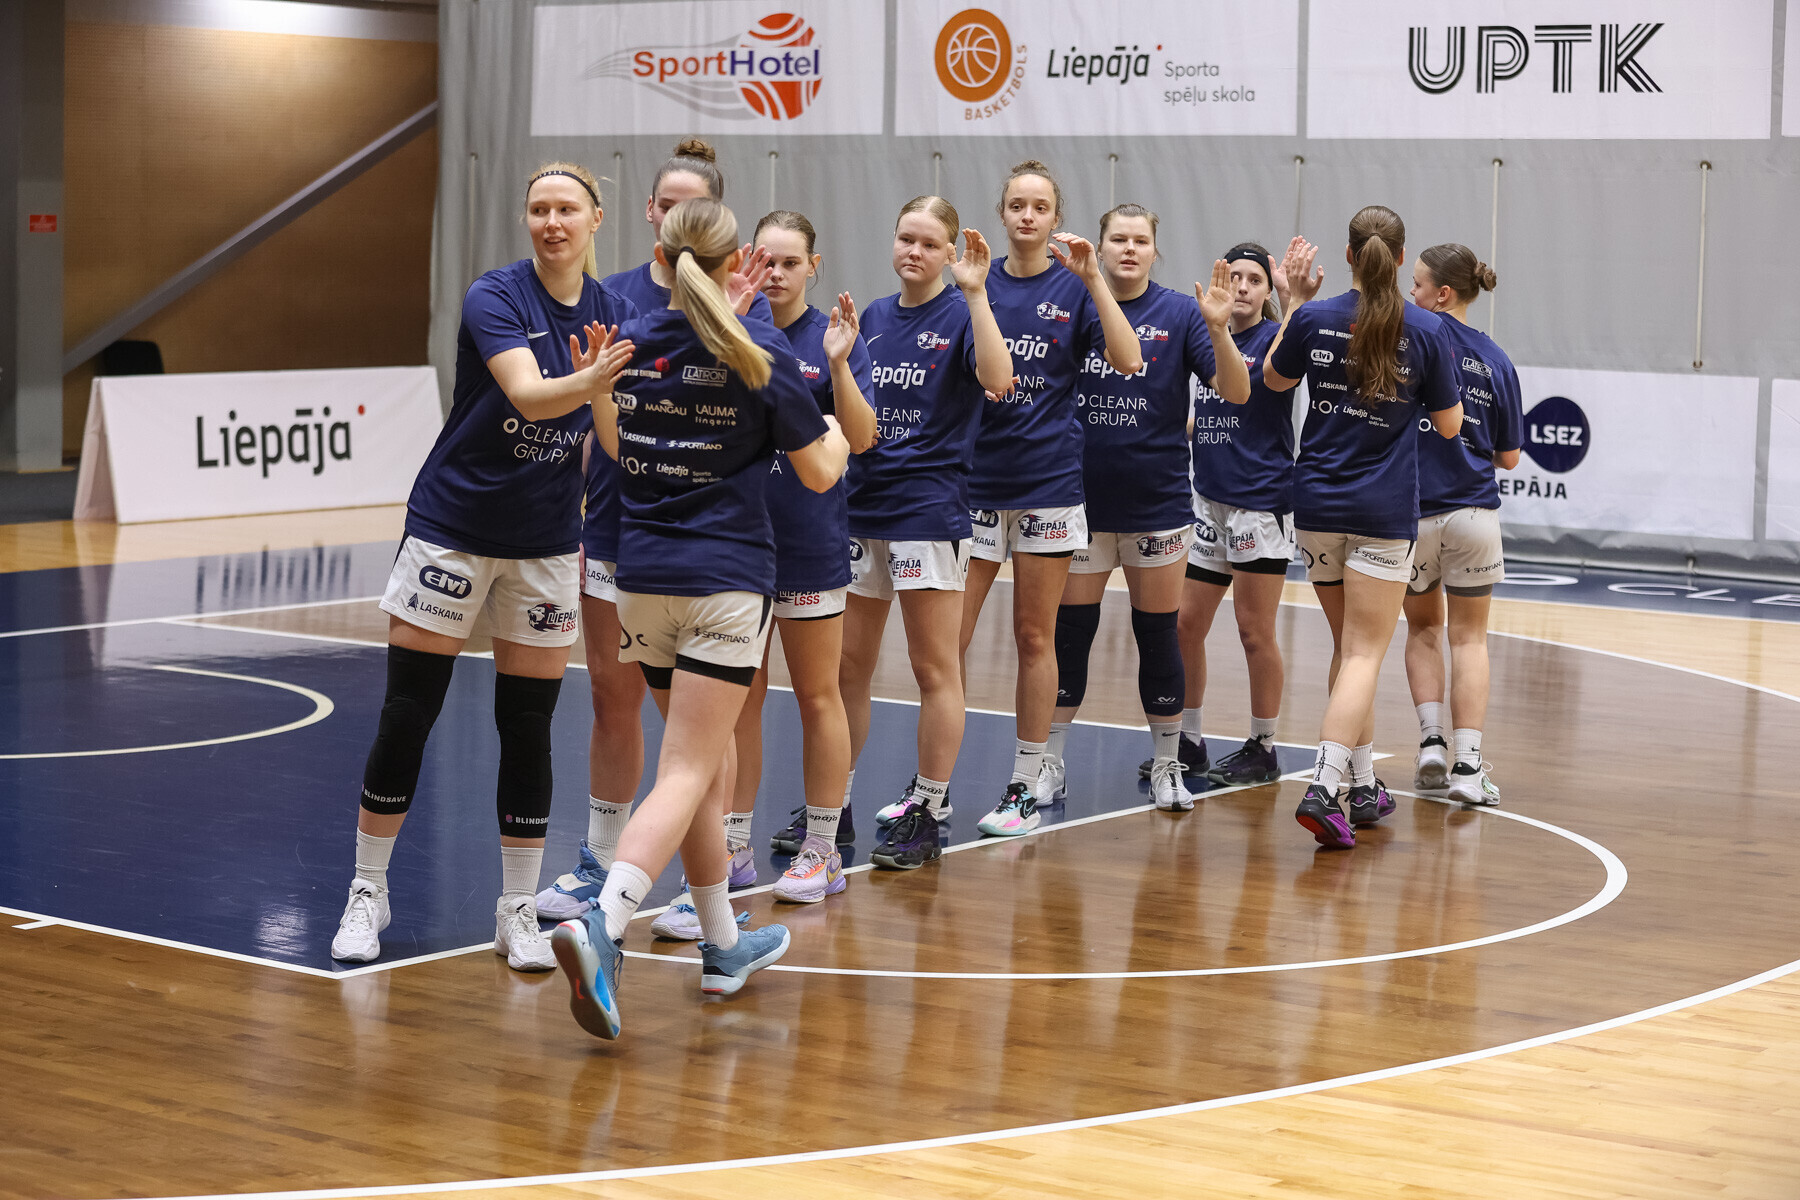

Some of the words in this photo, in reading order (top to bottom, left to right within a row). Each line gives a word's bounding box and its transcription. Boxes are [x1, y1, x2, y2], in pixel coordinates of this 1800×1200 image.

[633, 49, 820, 83] SportHotel
[1047, 45, 1151, 85] Liepāja
[1408, 22, 1665, 95] UPTK
[1164, 61, 1220, 78] Sporta
[964, 43, 1028, 121] BASKETBOLS
[1164, 86, 1209, 106] spēļu
[1212, 86, 1256, 102] skola
[686, 367, 726, 382] LATRON
[871, 360, 927, 390] epāja
[1319, 381, 1348, 392] LASKANA
[1467, 385, 1493, 401] LAUMA
[1089, 395, 1147, 411] CLEANR
[1465, 393, 1491, 408] lingerie
[695, 404, 736, 418] LAUMA
[875, 406, 922, 424] LEANR
[1342, 405, 1368, 419] Liepāja
[695, 416, 737, 427] lingerie
[1088, 411, 1138, 427] GRUPA
[1196, 416, 1240, 429] CLEANR
[623, 431, 657, 446] LASKANA
[876, 424, 911, 440] RUPA
[1197, 432, 1232, 444] GRUPA
[1530, 424, 1582, 446] LSEZ
[196, 406, 352, 478] Liepāja
[678, 440, 723, 450] SPORTLAND
[656, 463, 689, 477] Liepāja
[1500, 476, 1567, 500] EPĀJA
[1044, 529, 1068, 540] LSSS
[1164, 541, 1184, 555] LSSS
[1235, 540, 1256, 552] LSSS
[1361, 550, 1398, 566] SPORTLAND
[898, 568, 922, 578] LSSS
[794, 594, 820, 606] LSSS
[420, 602, 464, 622] LASKANA
[702, 630, 750, 644] SPORTLAND
[364, 789, 407, 803] BLINDSAVE
[515, 816, 549, 825] BLINDSA
